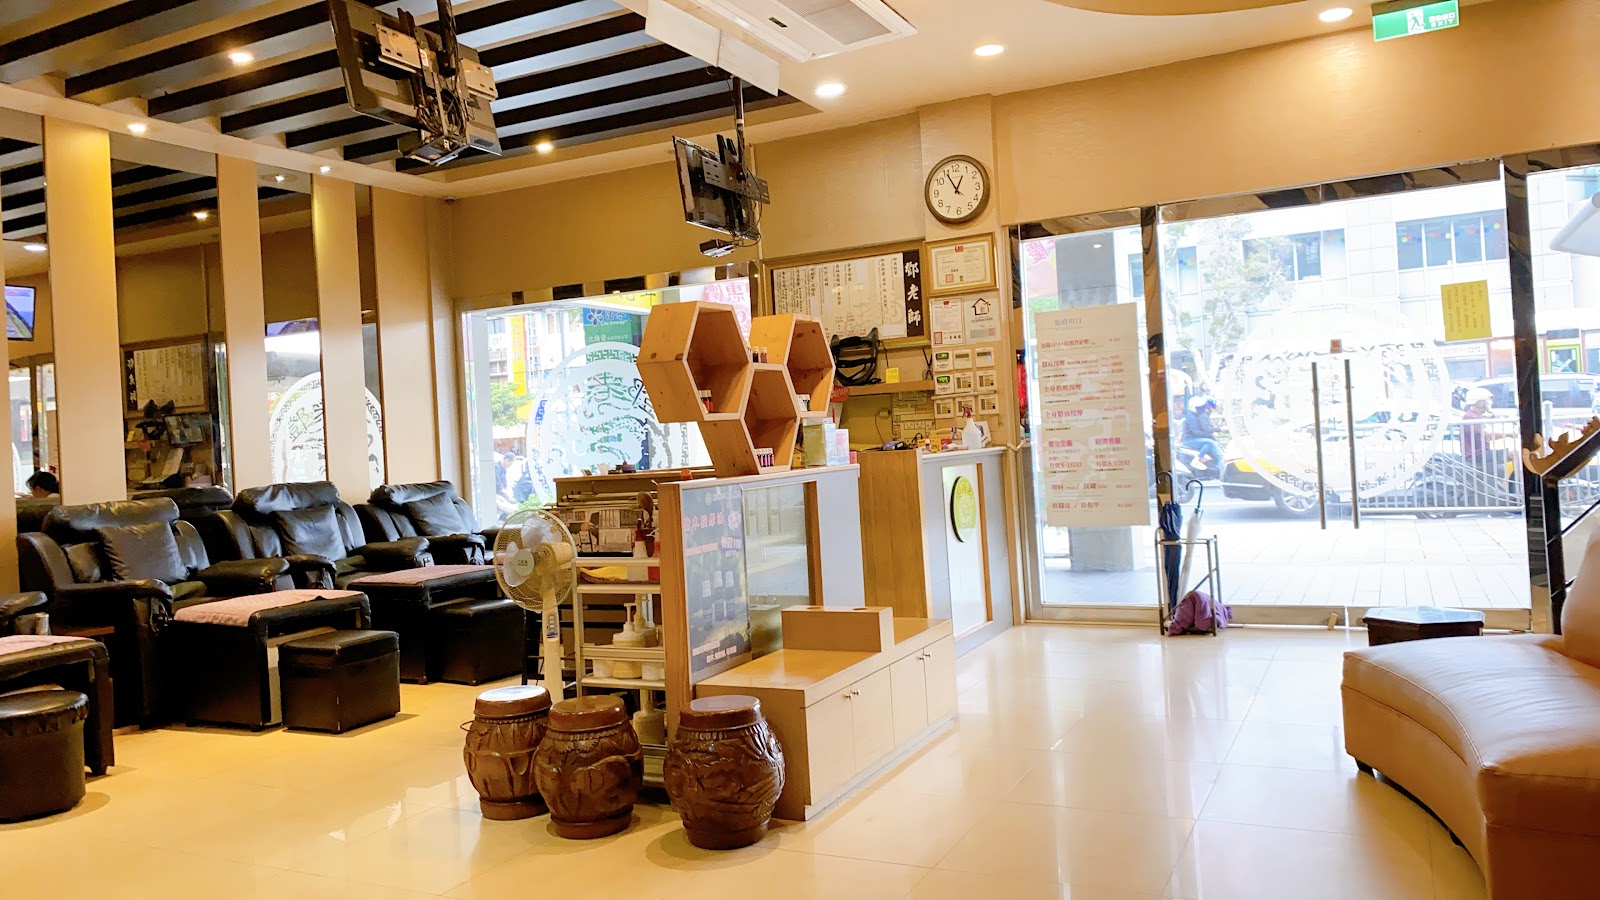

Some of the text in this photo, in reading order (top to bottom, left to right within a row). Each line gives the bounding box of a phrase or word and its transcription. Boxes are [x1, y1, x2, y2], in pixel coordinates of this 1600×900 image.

[1431, 19, 1453, 27] EXIT
[951, 163, 960, 173] 12
[936, 177, 945, 186] 10
[904, 260, 921, 327] 鄧老師
